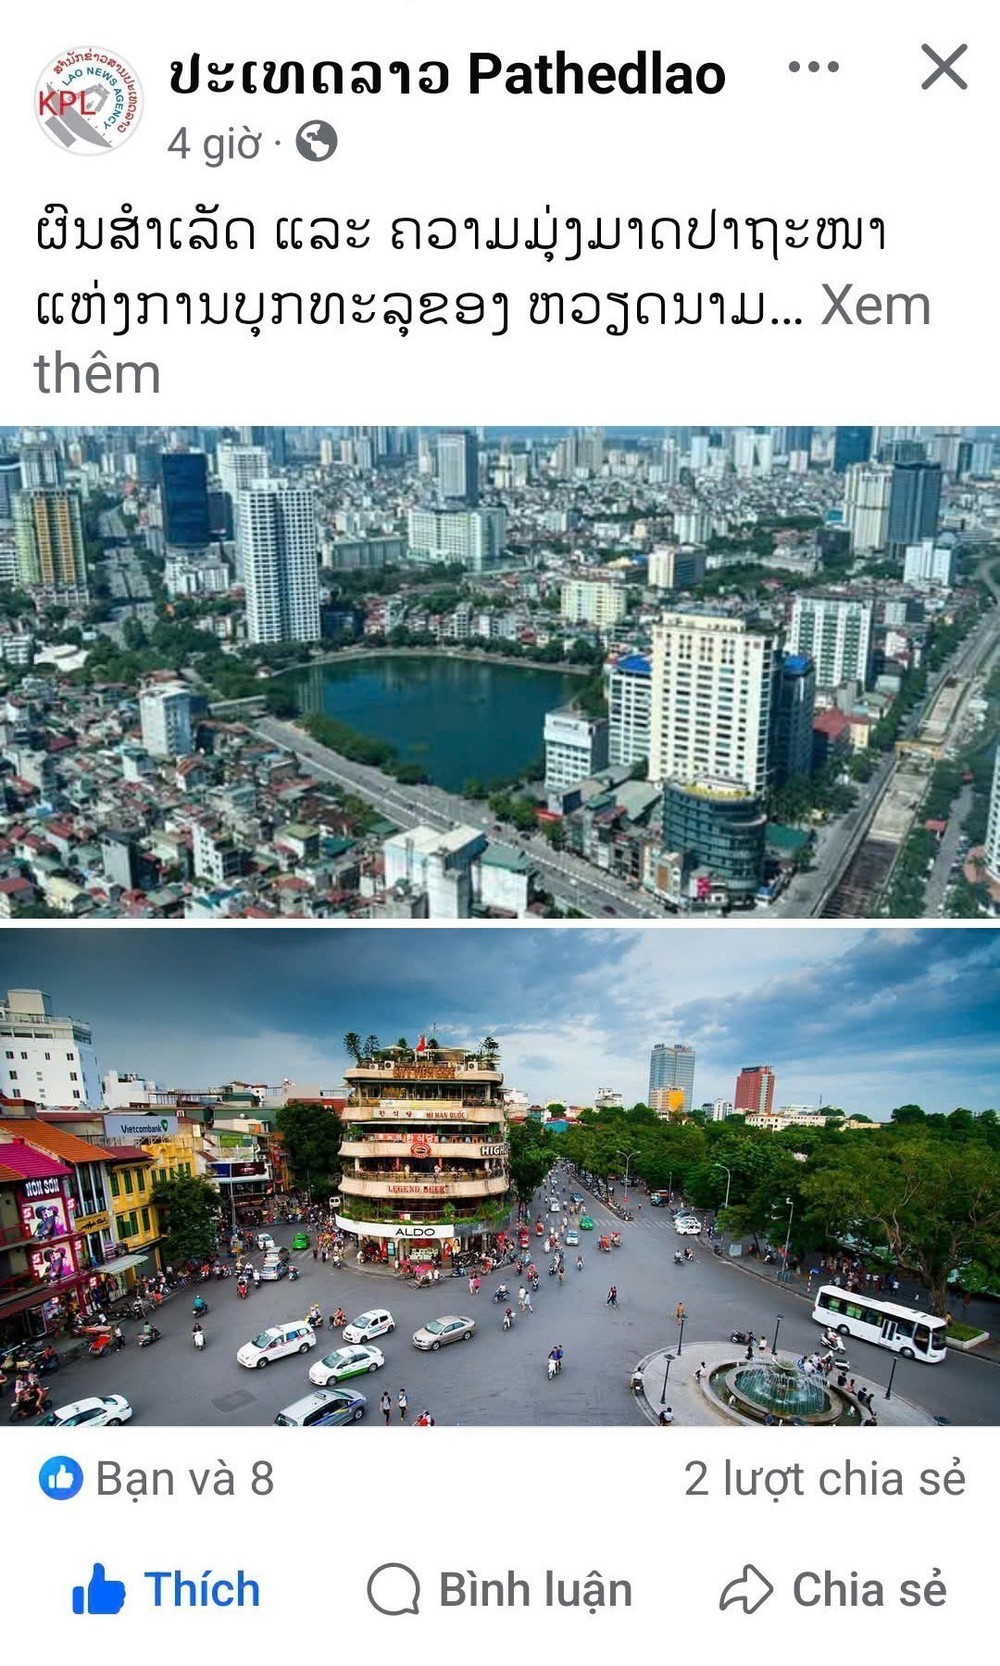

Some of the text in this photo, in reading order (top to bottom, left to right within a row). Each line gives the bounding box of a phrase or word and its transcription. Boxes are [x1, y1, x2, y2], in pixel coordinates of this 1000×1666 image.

[121, 1125, 161, 1134] Vietcombank
[388, 1186, 420, 1194] LEGEND
[395, 1228, 435, 1237] ALDO
